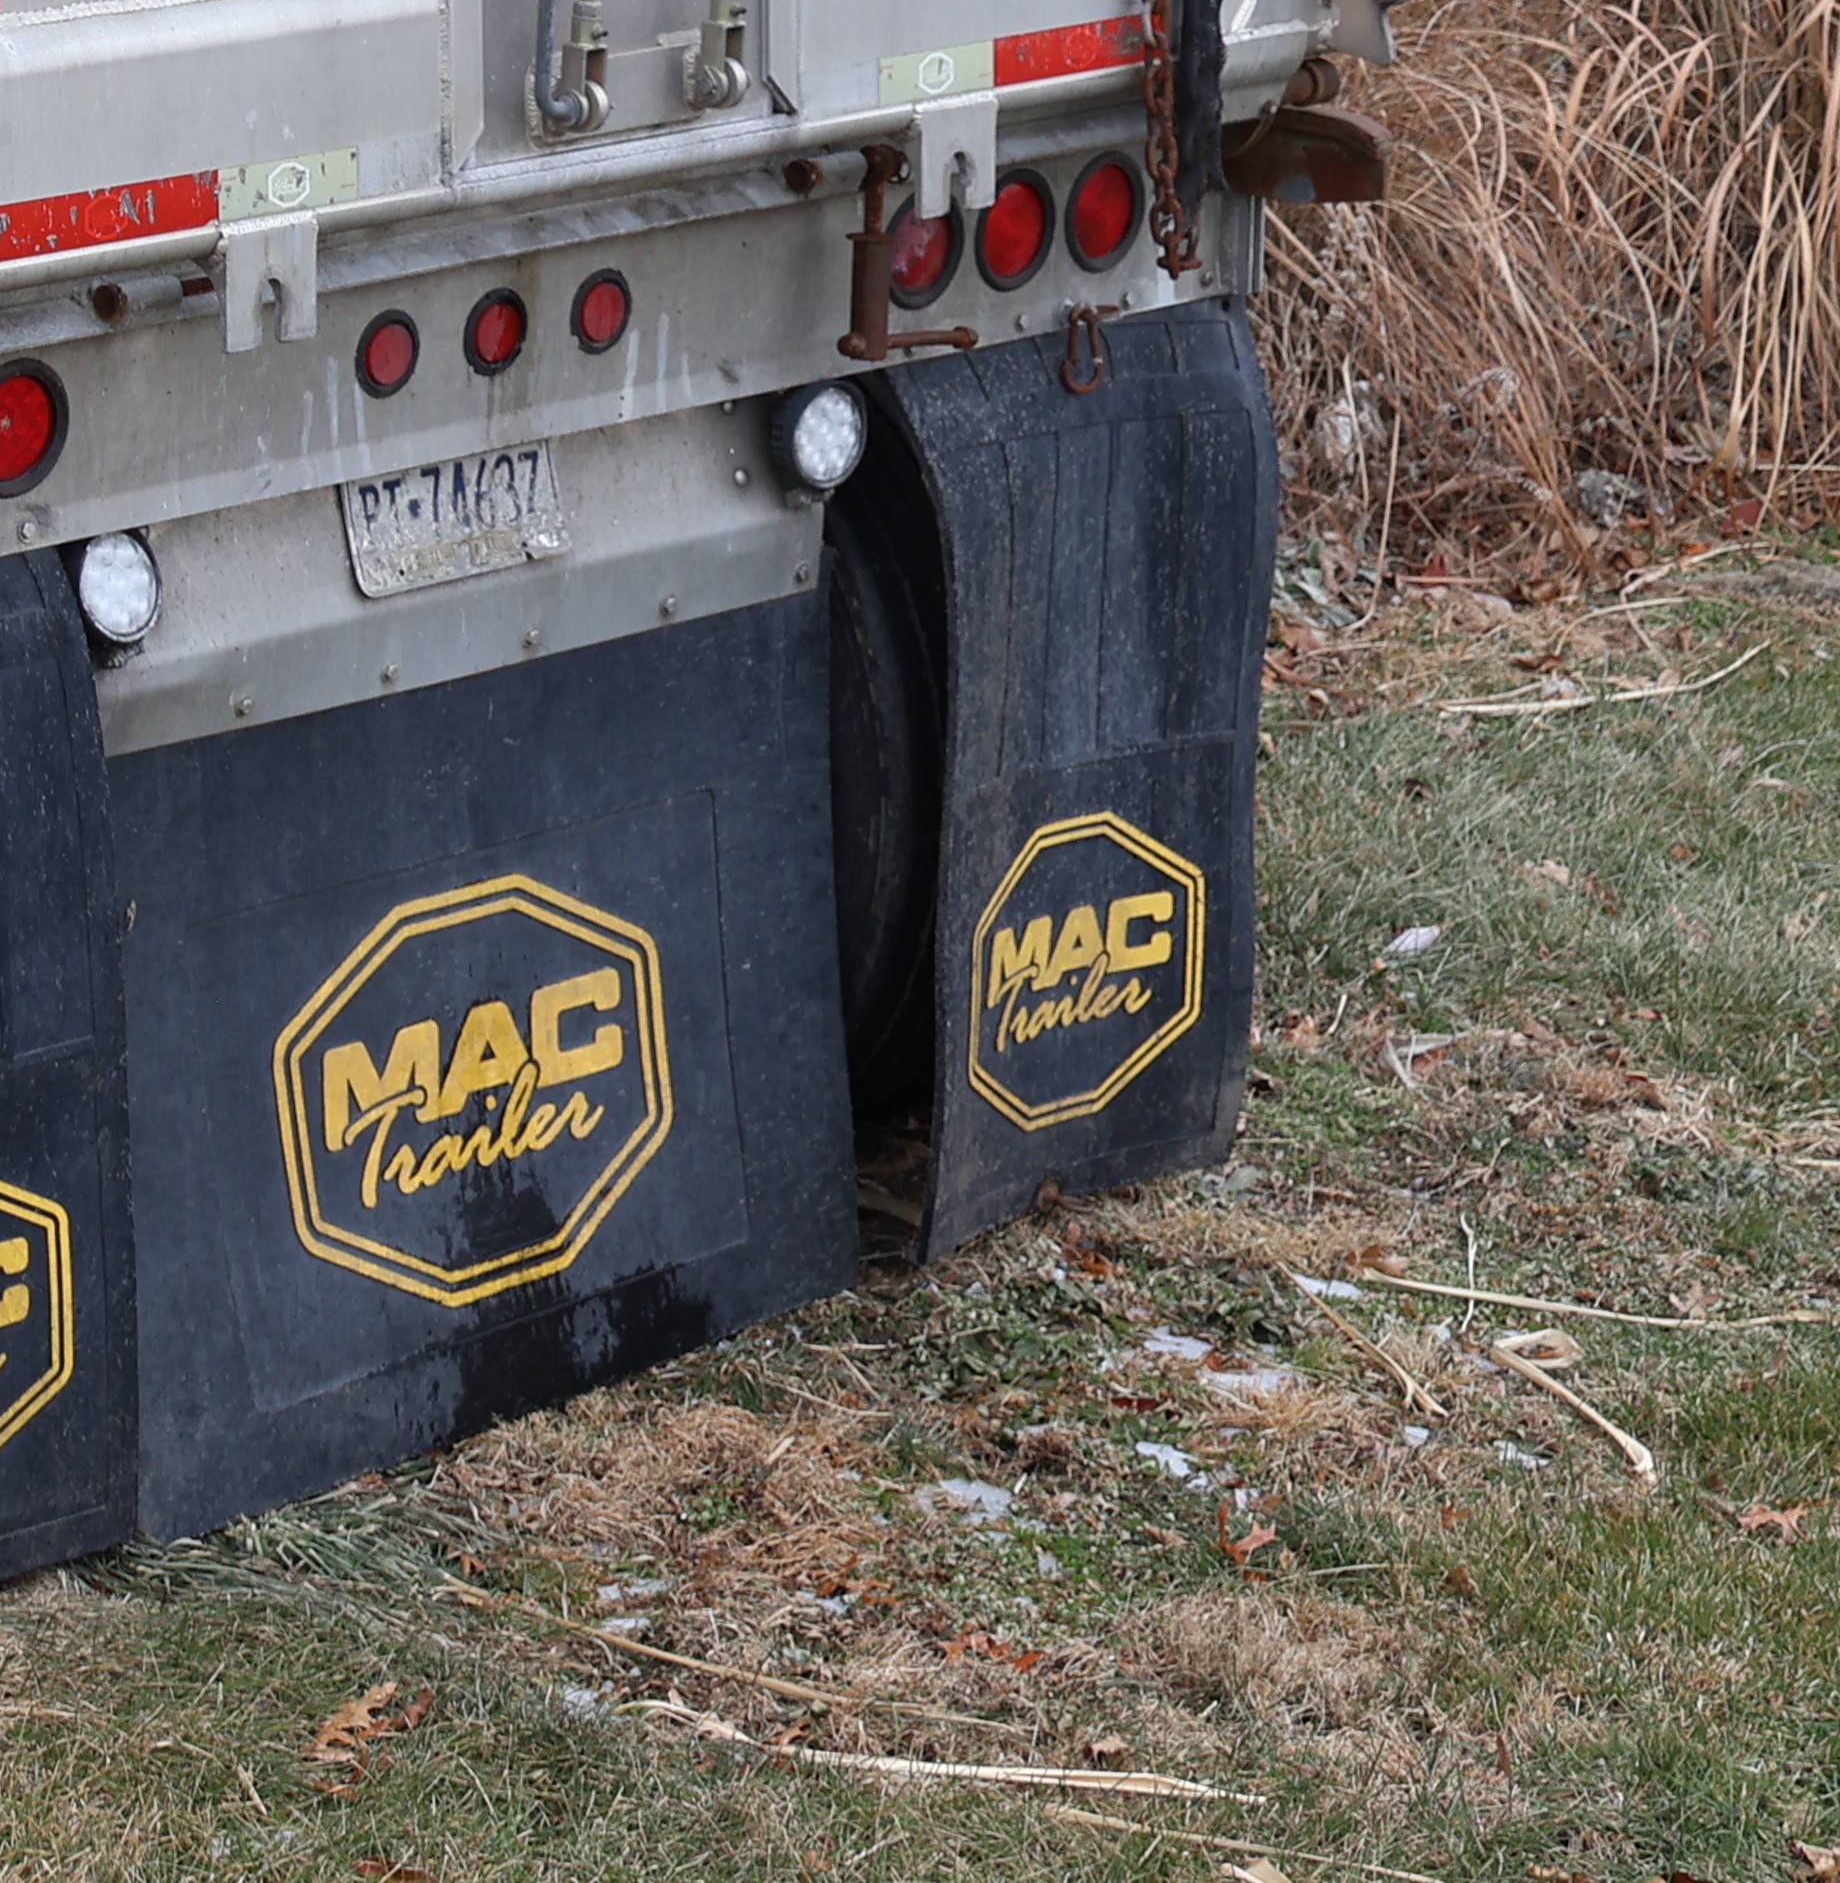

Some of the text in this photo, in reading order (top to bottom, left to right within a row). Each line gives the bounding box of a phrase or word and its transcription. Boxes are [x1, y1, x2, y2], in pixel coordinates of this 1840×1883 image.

[988, 891, 1174, 1009] MAC
[996, 954, 1153, 1053] Trailer
[321, 966, 624, 1152] MAC
[344, 1062, 604, 1209] Trailer
